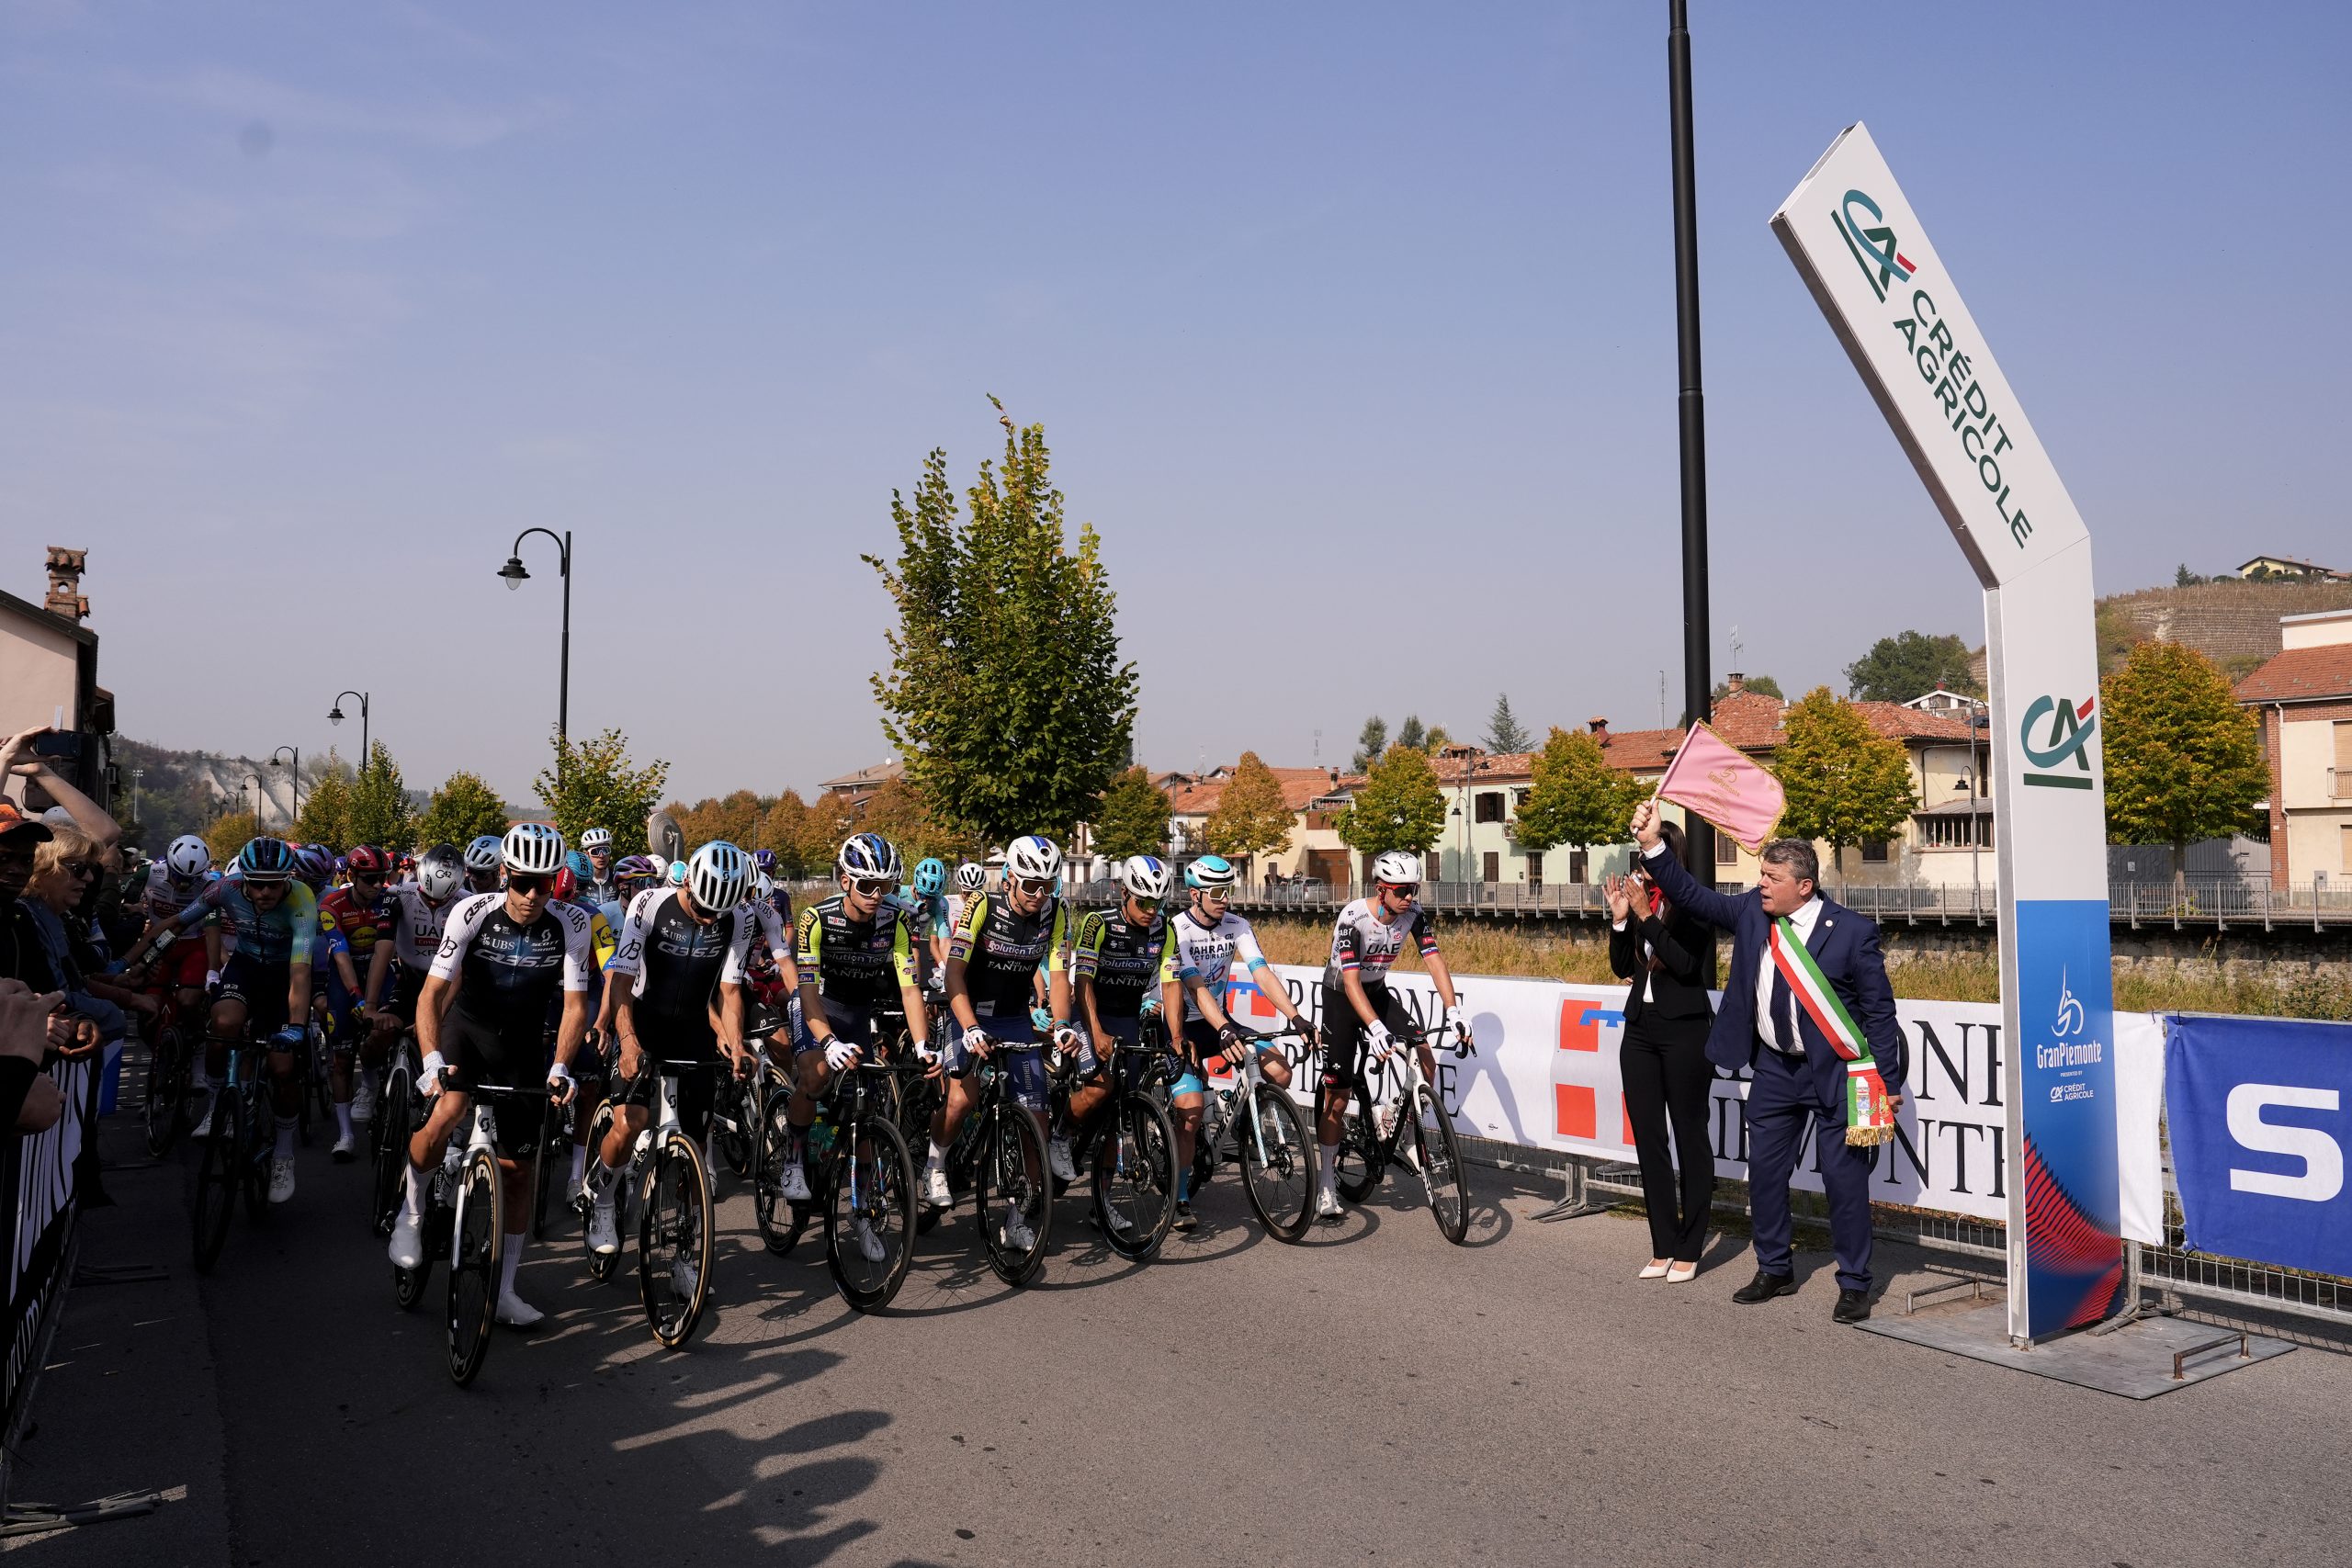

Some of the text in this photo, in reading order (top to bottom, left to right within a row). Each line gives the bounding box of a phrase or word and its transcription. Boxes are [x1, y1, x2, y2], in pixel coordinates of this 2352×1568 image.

[1912, 289, 2013, 457] CRÉDIT
[1893, 318, 2033, 549] AGRICOLE
[463, 894, 495, 926] Q36.5
[634, 890, 654, 930] Q36.5
[757, 901, 774, 919] UBS
[566, 906, 587, 933] UBS
[741, 914, 754, 941] UBS
[415, 924, 440, 937] UA
[670, 931, 687, 942] UBS
[492, 938, 515, 951] UBS
[657, 941, 725, 958] Q36.5
[987, 940, 1026, 955] Solution
[1028, 944, 1044, 955] Tech
[1189, 941, 1236, 955] BAHRAIN
[1366, 943, 1400, 954] UAE
[473, 948, 562, 968] Q36.5
[988, 961, 1033, 973] FANTINI
[2037, 1040, 2102, 1070] GranPiemonte
[2064, 1083, 2086, 1093] CRÉDIT
[2064, 1089, 2094, 1100] AGRICOLE
[1213, 1076, 1245, 1148] MERIDA
